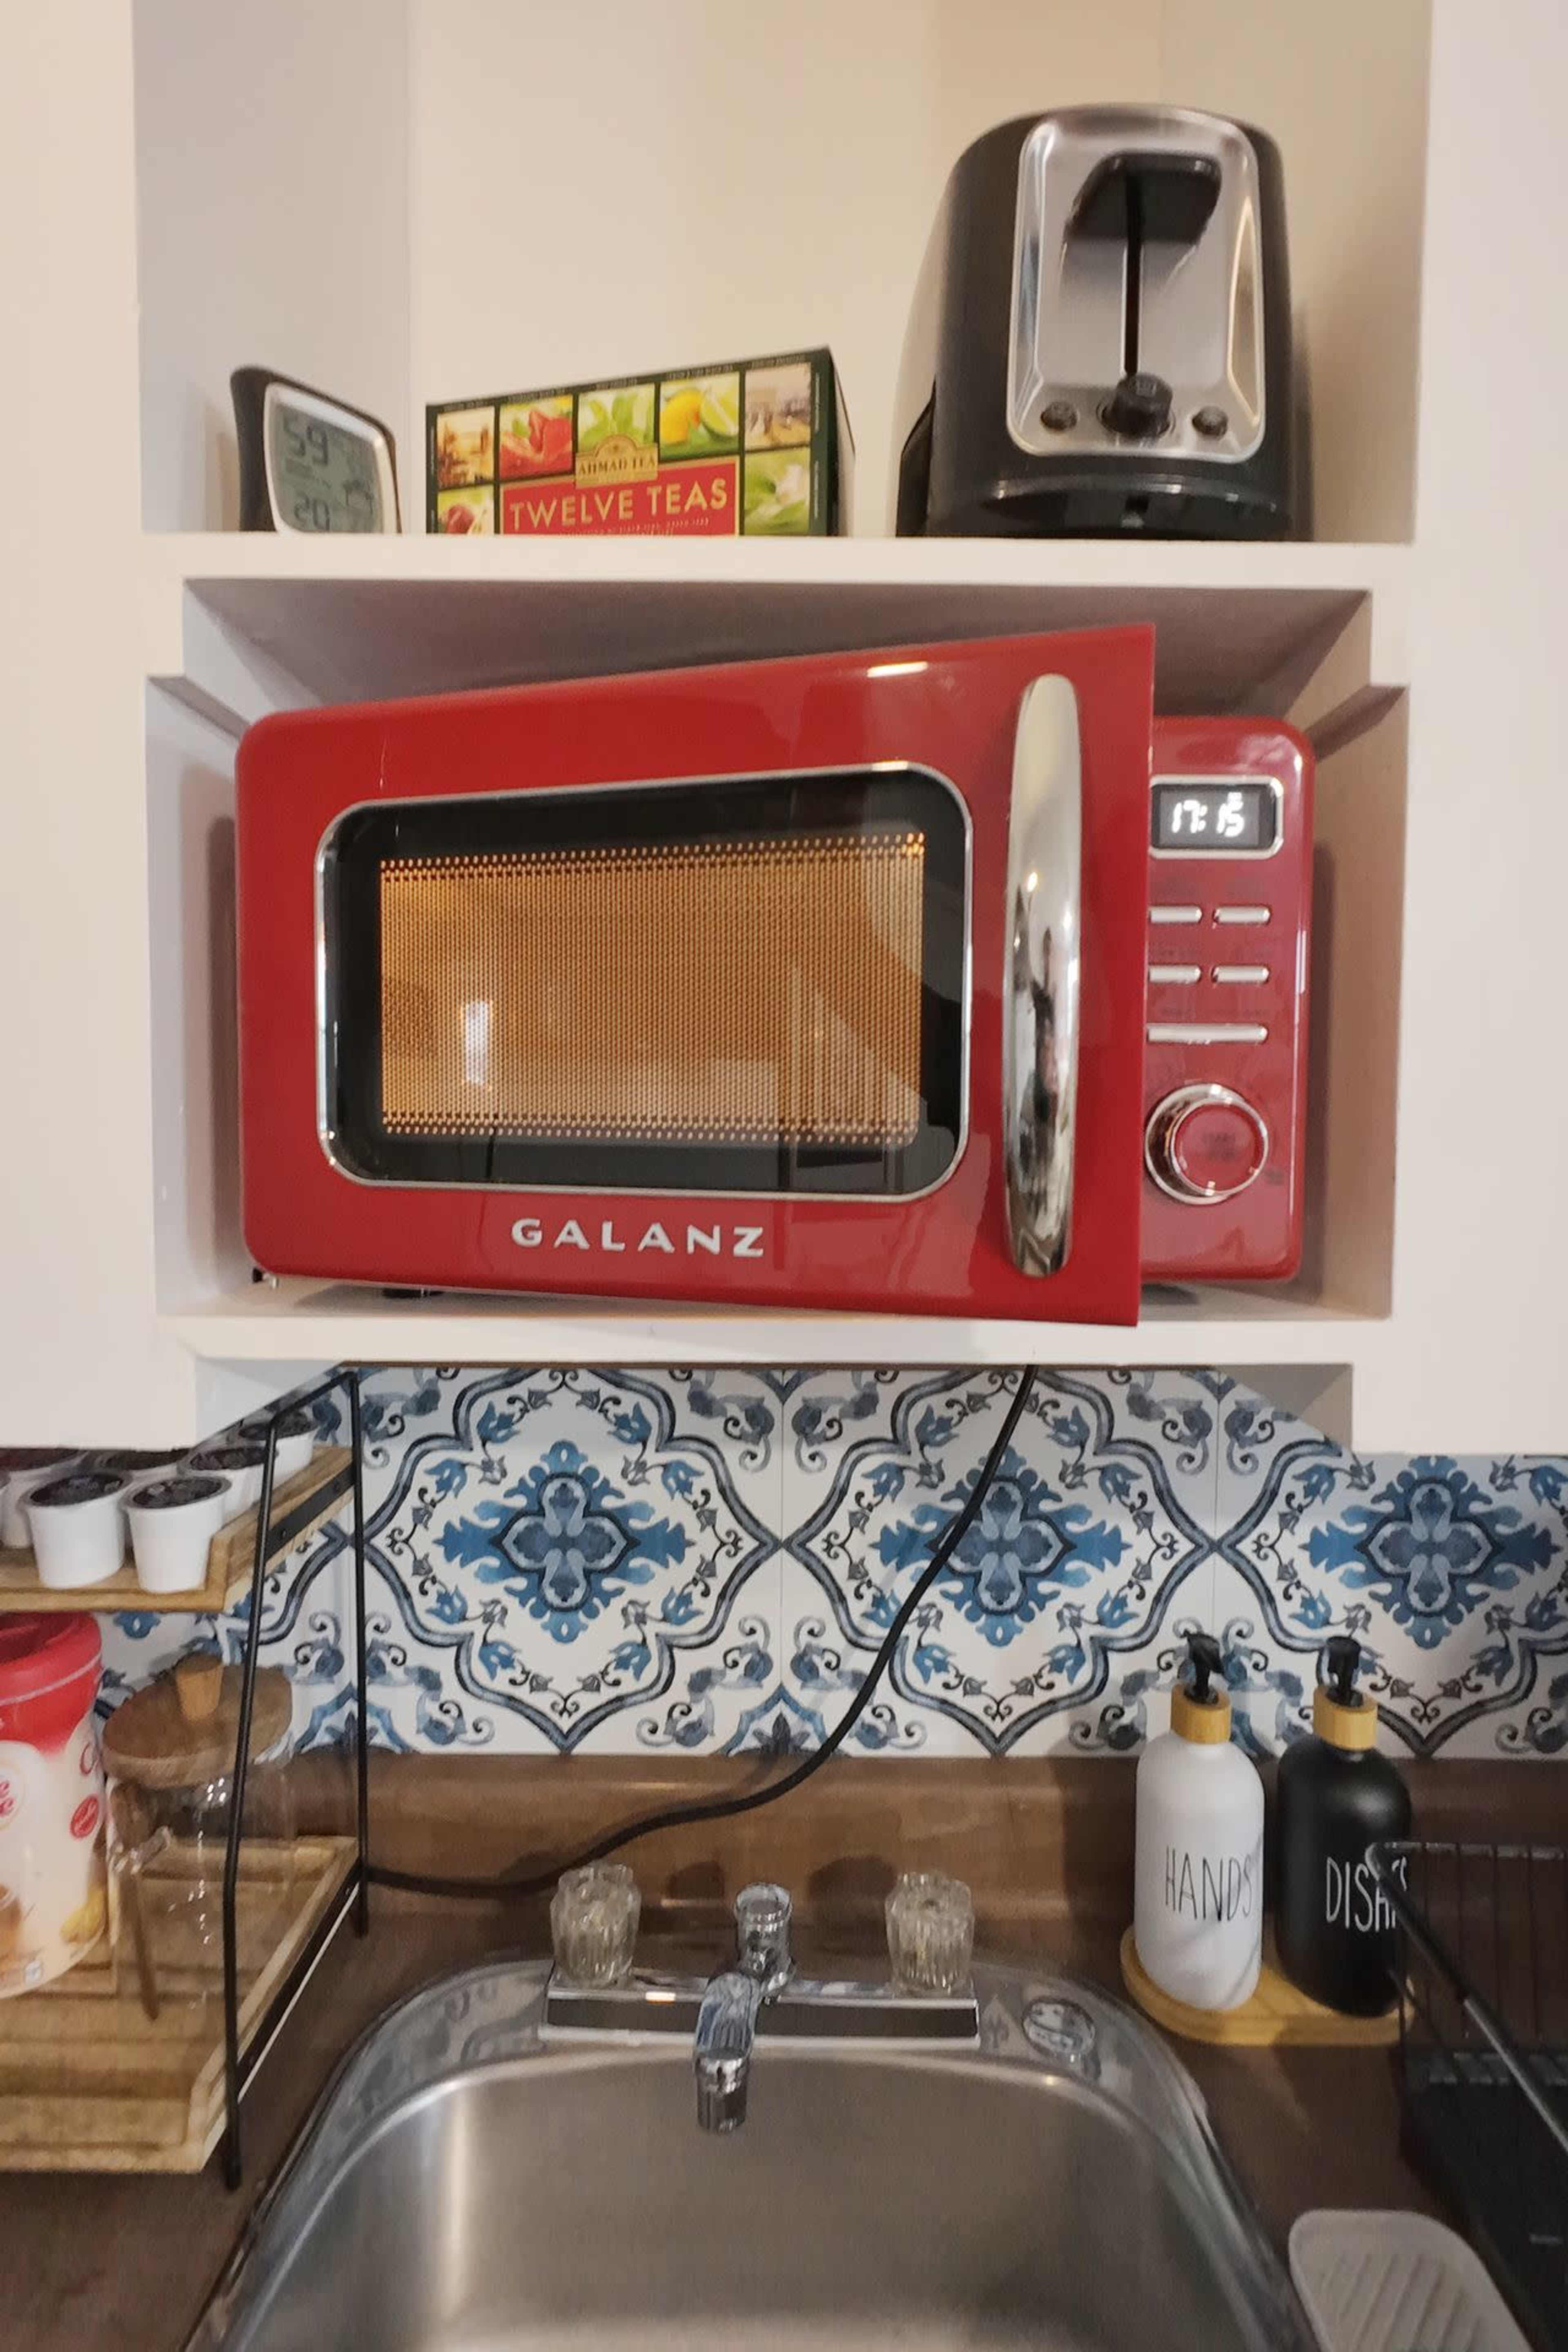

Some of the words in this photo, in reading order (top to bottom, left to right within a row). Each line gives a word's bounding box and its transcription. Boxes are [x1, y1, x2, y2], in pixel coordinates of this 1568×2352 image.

[579, 457, 628, 475] AHMAD
[631, 454, 655, 470] TEA
[510, 490, 633, 530] TWELVE
[646, 478, 727, 515] TEAS
[511, 1218, 764, 1257] GALANZ
[1165, 1845, 1252, 1921] HANDS
